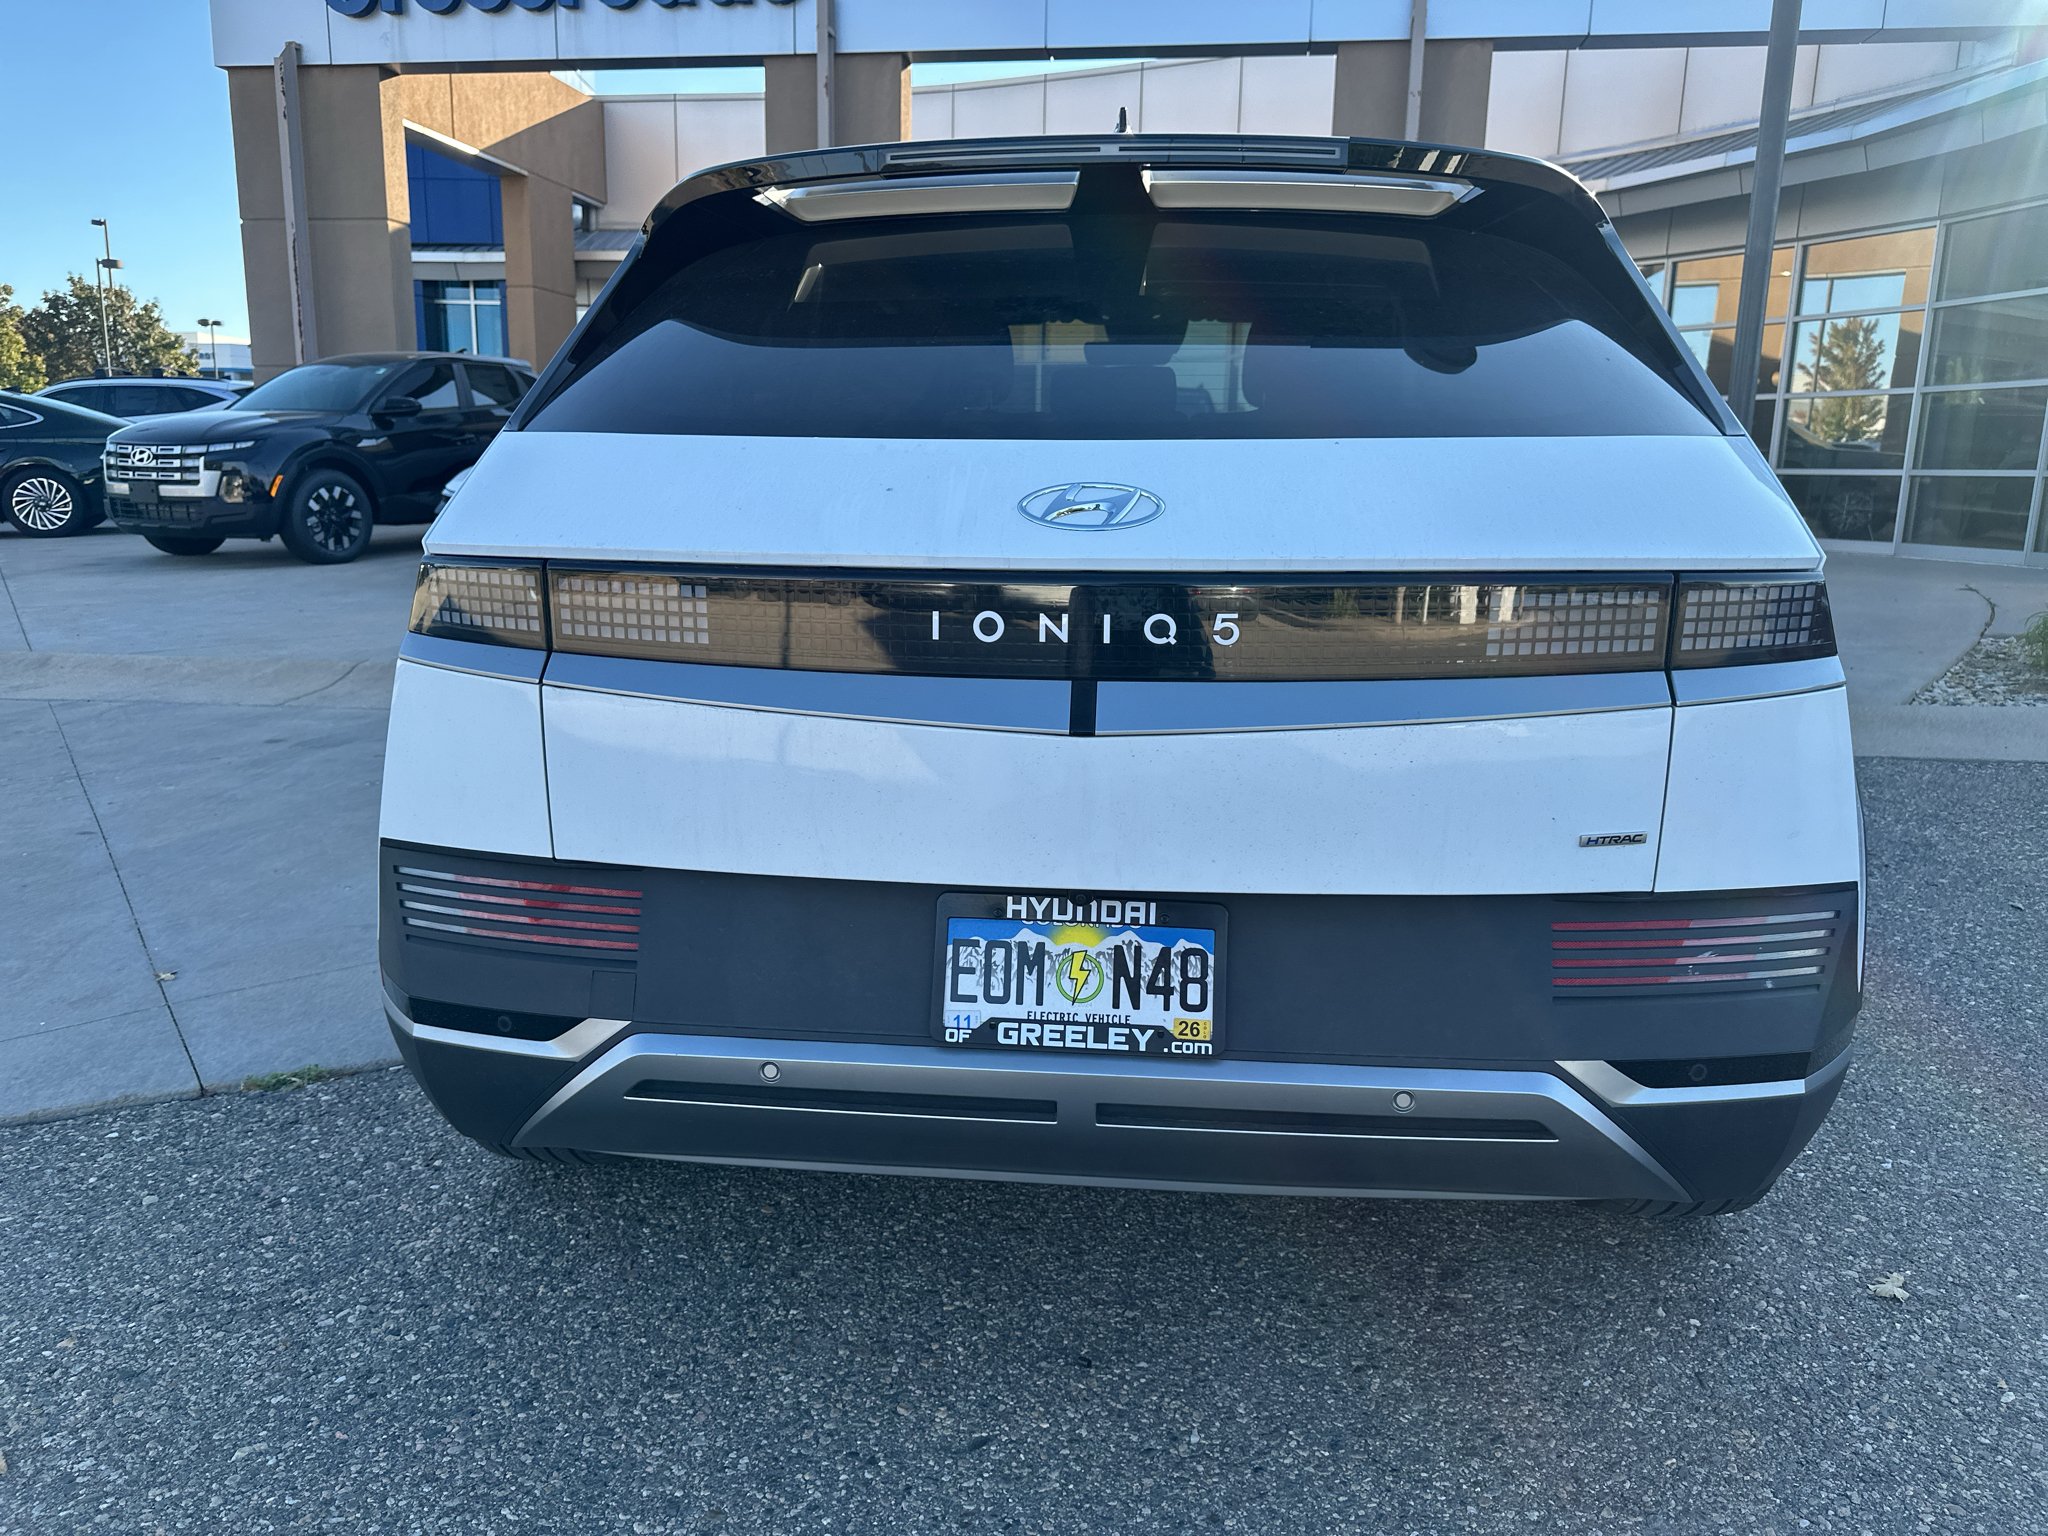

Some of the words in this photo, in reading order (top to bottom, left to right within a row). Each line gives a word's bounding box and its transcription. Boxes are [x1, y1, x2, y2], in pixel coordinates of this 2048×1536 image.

[931, 609, 1178, 646] IONIQ
[1212, 612, 1241, 647] 5
[1585, 833, 1645, 846] HTRAC
[1111, 944, 1209, 1013] N48
[953, 1013, 972, 1029] 11
[1026, 1010, 1079, 1023] ELECTRIC
[1085, 1012, 1132, 1025] VEHICLE
[944, 1028, 973, 1044] OF
[997, 1021, 1155, 1052] GREELEY
[1177, 1020, 1201, 1038] 26
